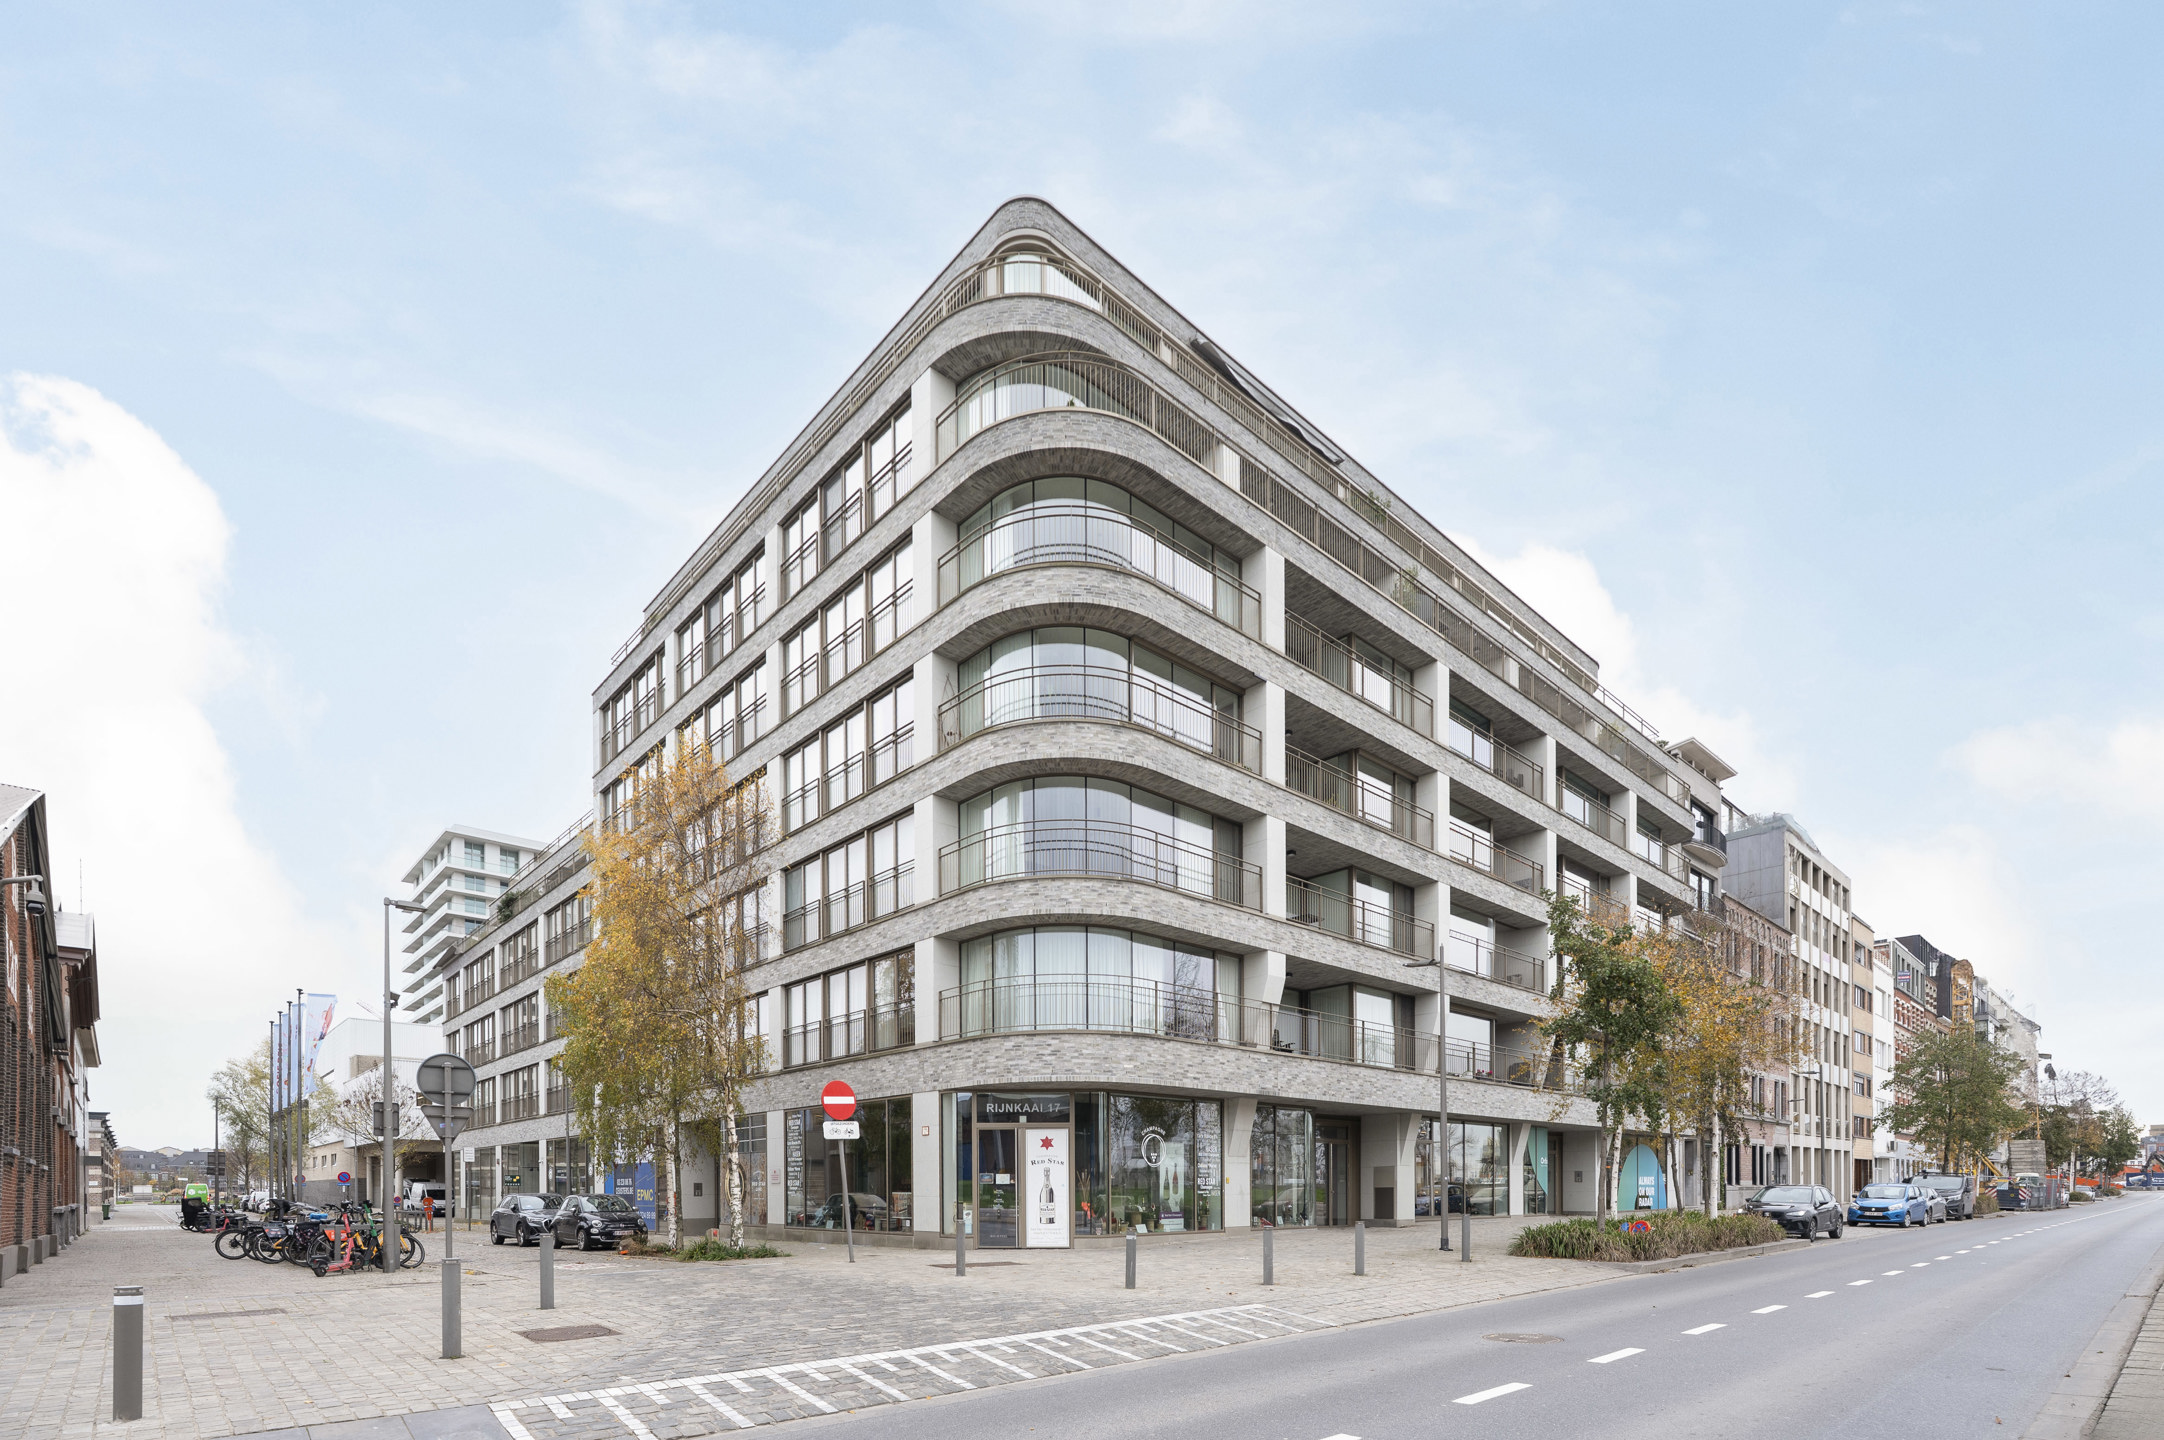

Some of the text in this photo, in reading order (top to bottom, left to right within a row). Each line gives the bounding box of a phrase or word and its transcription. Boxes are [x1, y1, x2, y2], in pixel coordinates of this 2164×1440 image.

[987, 1103, 1060, 1112] RIJNKAAI 17
[1639, 1176, 1655, 1186] ALWAYS
[637, 1189, 653, 1200] EPMC
[1646, 1187, 1655, 1196] OUR
[1638, 1197, 1653, 1206] RADAR
